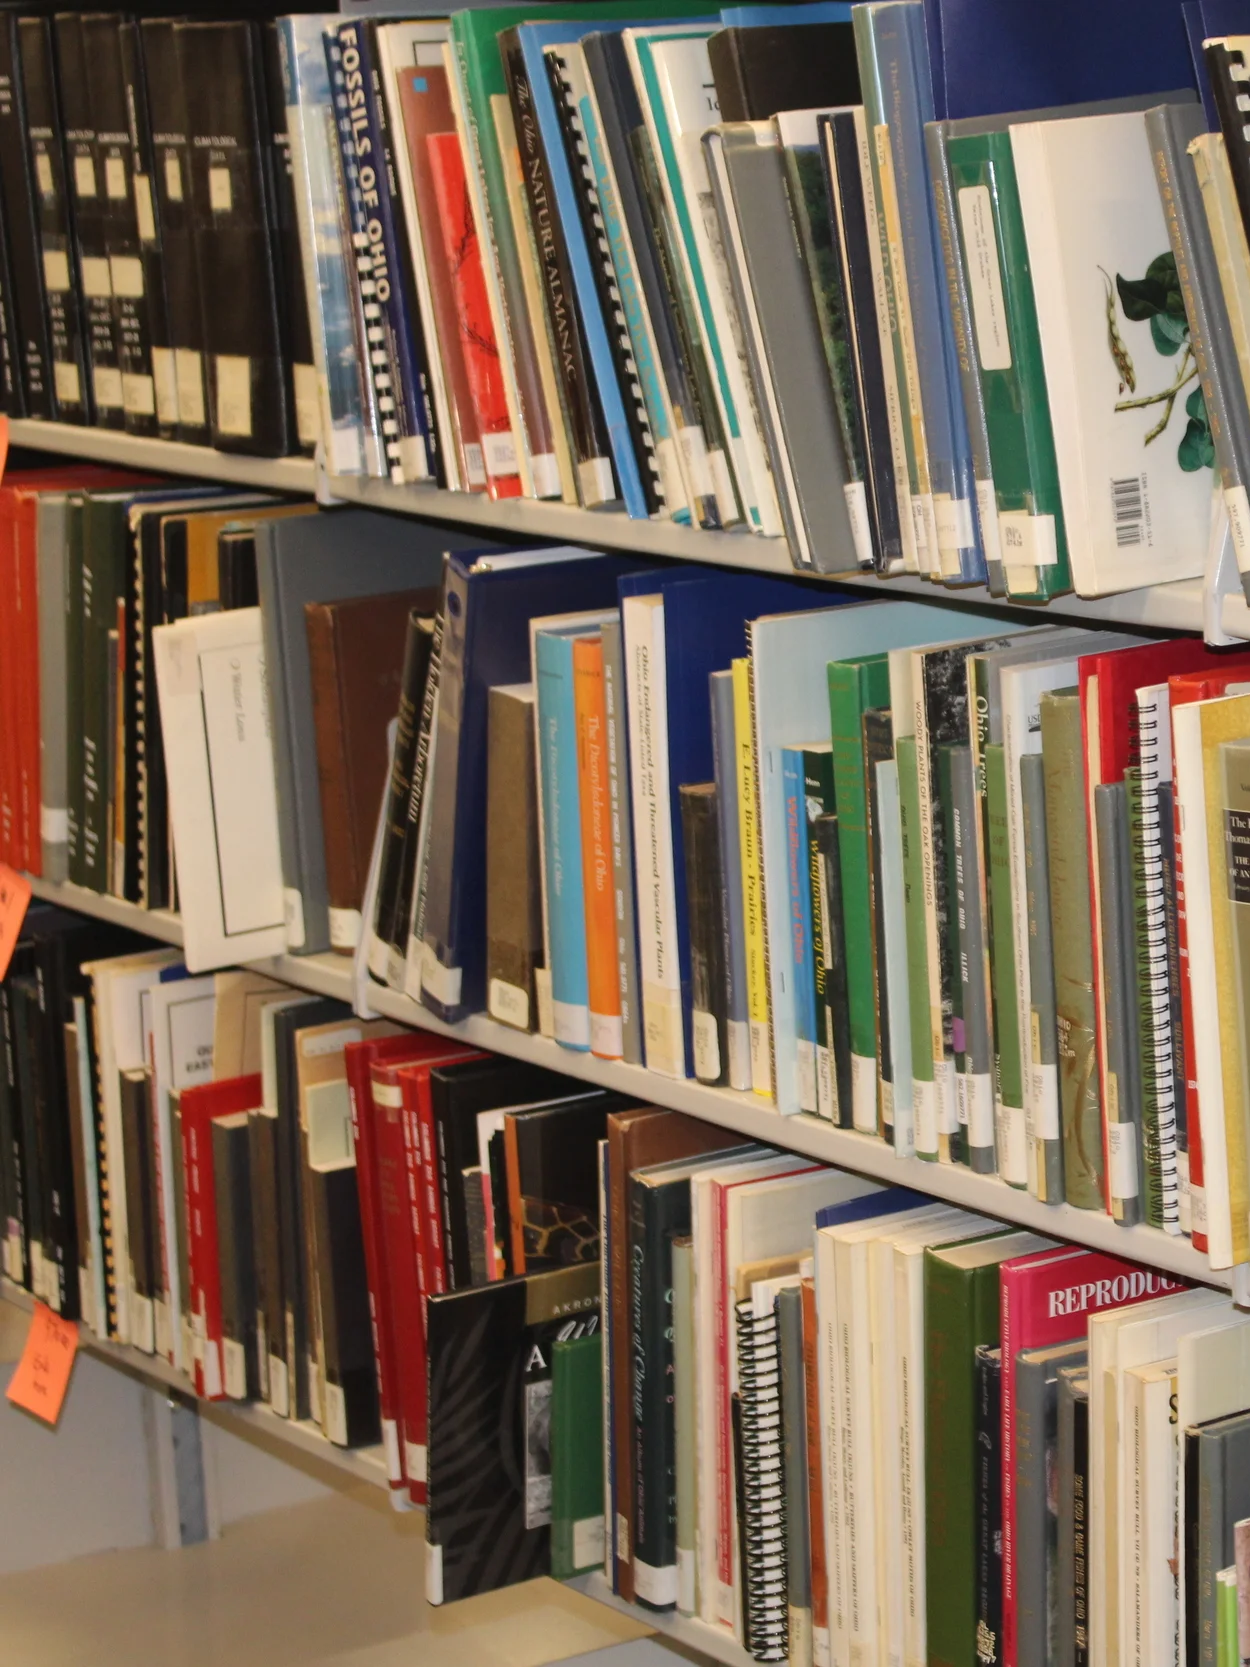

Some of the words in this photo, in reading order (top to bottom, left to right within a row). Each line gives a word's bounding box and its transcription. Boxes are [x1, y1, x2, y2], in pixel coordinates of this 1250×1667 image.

[337, 26, 372, 157] FOSSILS
[513, 72, 531, 108] The
[521, 112, 539, 154] Ohio
[357, 165, 379, 210] OF
[527, 157, 557, 261] NATURE
[365, 217, 391, 304] OHIO
[546, 265, 578, 382] ALMANAC
[914, 701, 923, 741] WOODY
[917, 745, 926, 782] PLANTS
[919, 786, 927, 799] OF
[920, 803, 928, 821] THE
[921, 827, 930, 848] OAK
[807, 839, 824, 932] Wildflowers
[923, 851, 933, 907] OPENINGS
[813, 936, 825, 951] of
[814, 957, 826, 995] Ohio
[628, 1244, 647, 1330] Creatures
[1048, 1271, 1182, 1318] REPRODUC
[632, 1332, 646, 1350] of
[631, 1354, 649, 1422] Change
